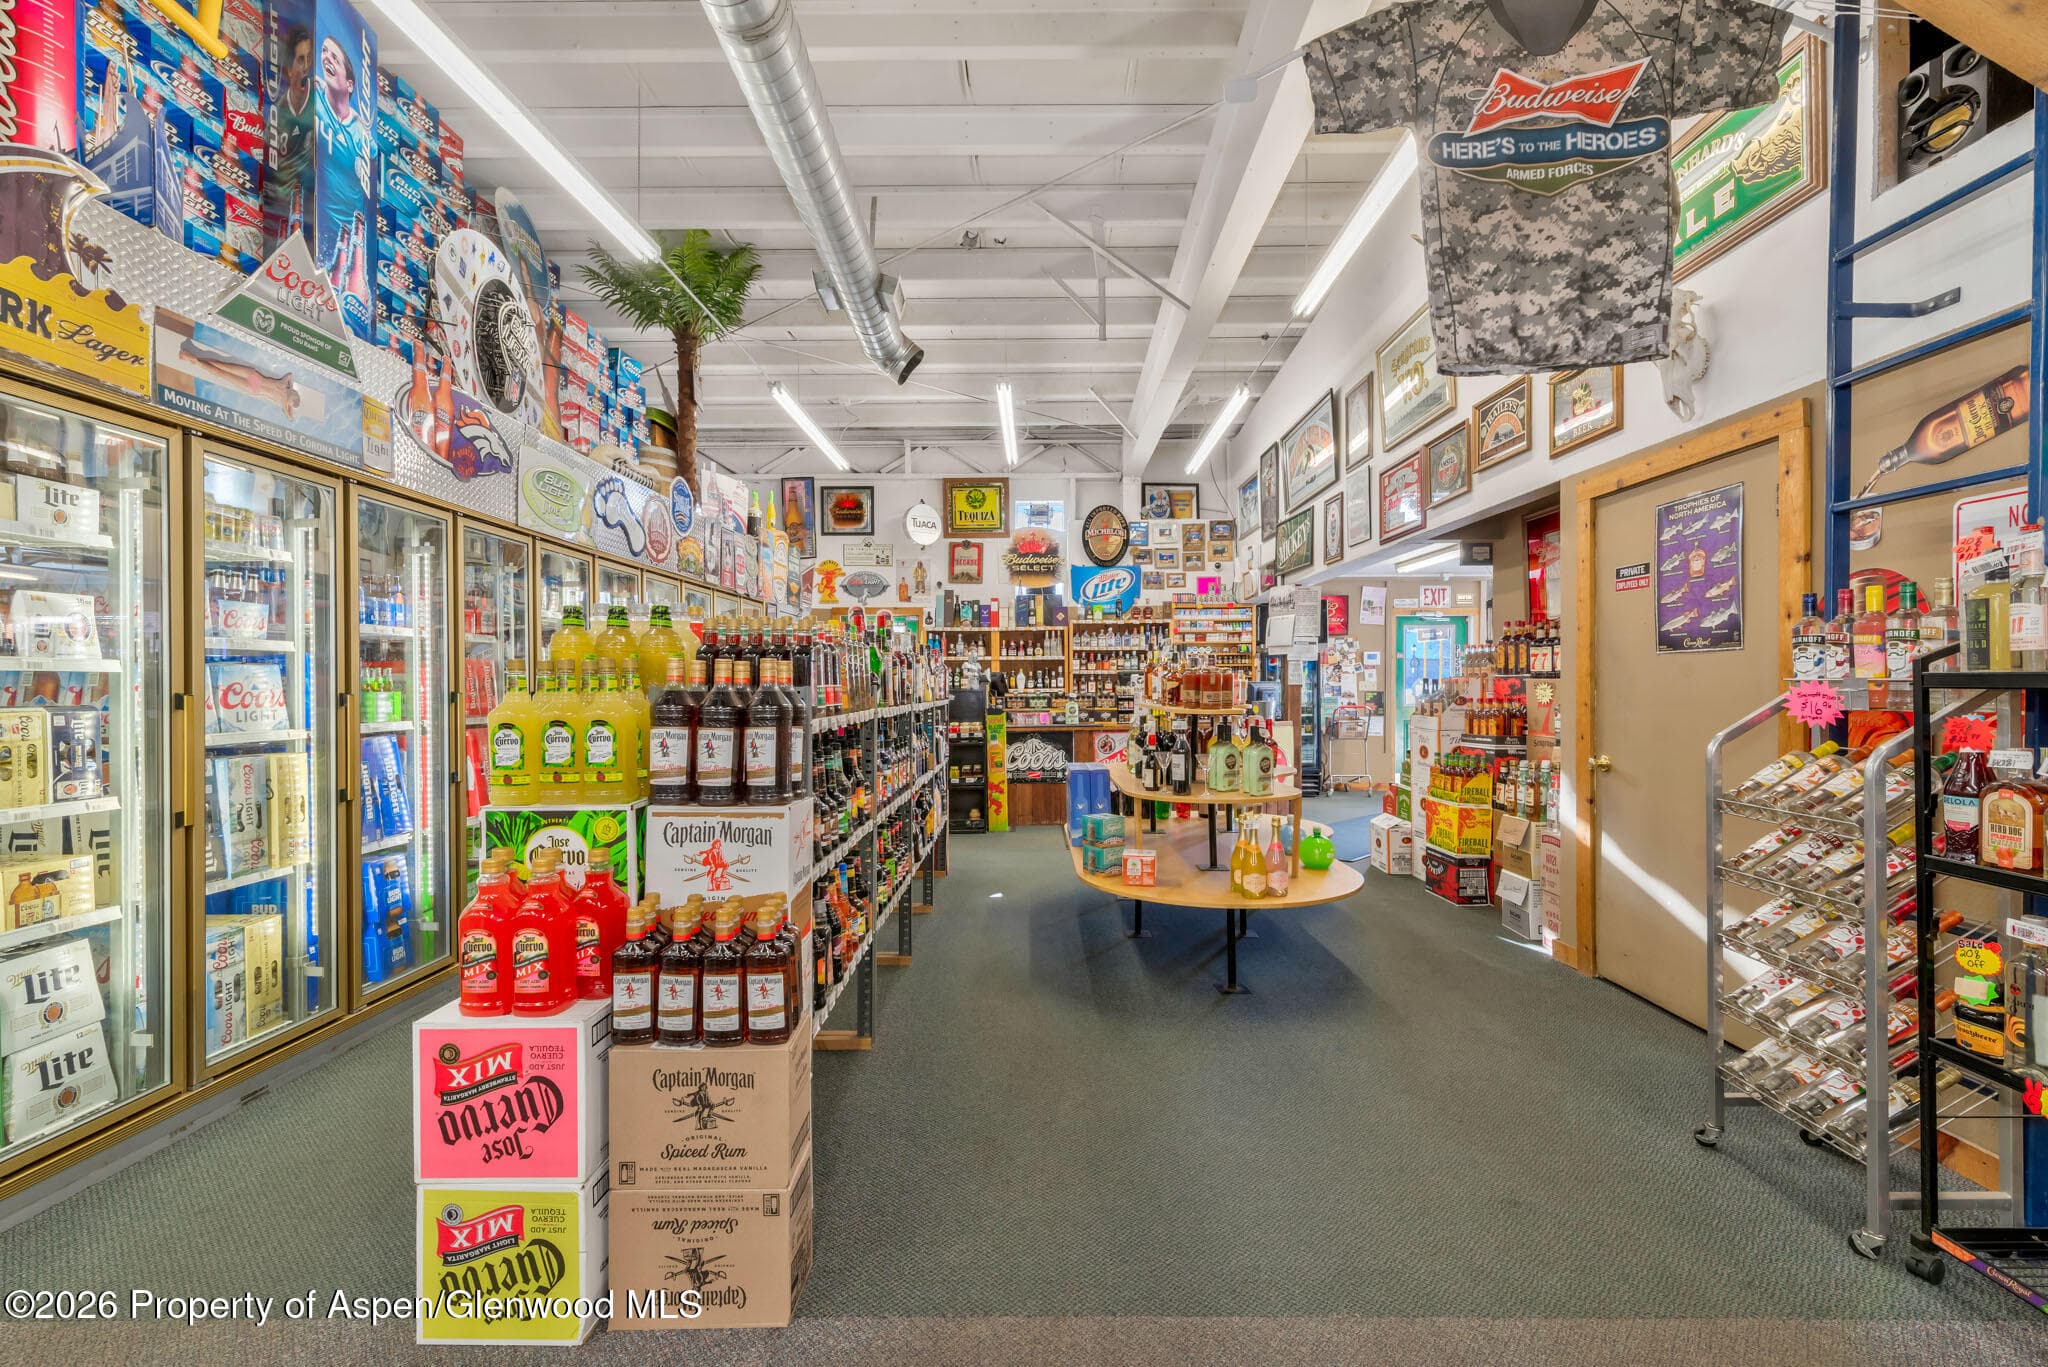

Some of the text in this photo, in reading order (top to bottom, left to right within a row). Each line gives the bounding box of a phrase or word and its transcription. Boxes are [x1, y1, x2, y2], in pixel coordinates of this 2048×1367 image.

[88, 9, 138, 47] BUD
[161, 71, 218, 113] LIGHT
[172, 69, 214, 103] BUD
[269, 3, 279, 171] BUD LIGHT
[1466, 82, 1640, 117] Budweiser
[1442, 126, 1657, 160] HERE'S TO THE HEROES
[203, 154, 254, 188] LIGHT
[213, 152, 250, 179] BUD
[360, 130, 371, 199] BUD
[412, 153, 437, 175] BUD
[1506, 163, 1594, 181] ARMED FORCES
[389, 181, 423, 208] LIGHT
[396, 175, 421, 199] BUD
[266, 252, 338, 312] Coors
[277, 286, 324, 322] LIGHT
[58, 319, 146, 368] Lager
[279, 322, 300, 336] PROUD
[300, 330, 325, 349] SPONSOR
[303, 340, 319, 352] RAMS
[1486, 400, 1518, 425] BAILEYS
[1573, 423, 1593, 437] BEER
[538, 481, 574, 503] LIGHT
[542, 473, 571, 492] BUD
[42, 486, 80, 507] Lite
[1674, 494, 1721, 512] TROPHIES OF
[957, 510, 995, 522] TEQUIZA
[1669, 501, 1727, 521] NORTH AMERICA
[911, 517, 937, 530] TUACA
[1087, 528, 1125, 538] MICHELOB
[1279, 519, 1311, 568] MICKEY'S
[1003, 552, 1064, 566] Budweiser
[1012, 564, 1056, 572] SELECT
[1619, 565, 1646, 577] PRIVATE
[1092, 577, 1128, 599] Lite
[1616, 578, 1649, 590] EMPLOYEES ONLY
[1423, 588, 1448, 606] EXIT
[223, 610, 267, 632] Coors
[1530, 653, 1539, 670] 7
[1541, 652, 1549, 668] 7
[217, 682, 286, 710] Coors
[236, 709, 278, 724] LIGHT
[495, 737, 519, 747] Cuervo
[545, 734, 570, 745] Cuervo
[588, 733, 612, 744] Cuervo
[665, 730, 687, 742] Morgan
[711, 731, 732, 742] Morgan
[753, 731, 775, 741] Morgan
[1006, 741, 1068, 771] Coors
[242, 764, 255, 826] Coors LIGHT
[361, 762, 374, 821] BUD LIGHT
[384, 757, 401, 816] BUD LIGHT
[1461, 787, 1490, 796] FIREBALL
[663, 820, 772, 848] Captain Morgan
[1990, 823, 2022, 836] BIRD DOG
[547, 835, 570, 848] Jose
[1458, 838, 1489, 848] FIREBALL
[252, 904, 277, 915] BUD
[463, 942, 492, 953] Cuervo
[515, 942, 544, 952] Cuervo
[1958, 940, 1983, 949] Sale
[463, 961, 492, 978] MIX
[515, 961, 544, 978] MIX
[6, 964, 82, 1006] Miller Lite
[221, 982, 234, 1045] Coors LIGHT
[20, 1046, 94, 1092] Miller Lite
[449, 1052, 512, 1087] MIX
[652, 1067, 754, 1092] Captain Morgan
[443, 1074, 516, 1102] STRAWBERRY MARGARITA
[438, 1076, 564, 1146] Cuervo
[481, 1127, 533, 1163] Jose
[660, 1142, 747, 1161] Spiced Rum
[450, 1213, 514, 1248] MIX
[653, 1217, 739, 1235] Spiced Rum
[447, 1237, 516, 1262] LIGHT MARGARITA
[1986, 1266, 2033, 1297] Crown Royal
